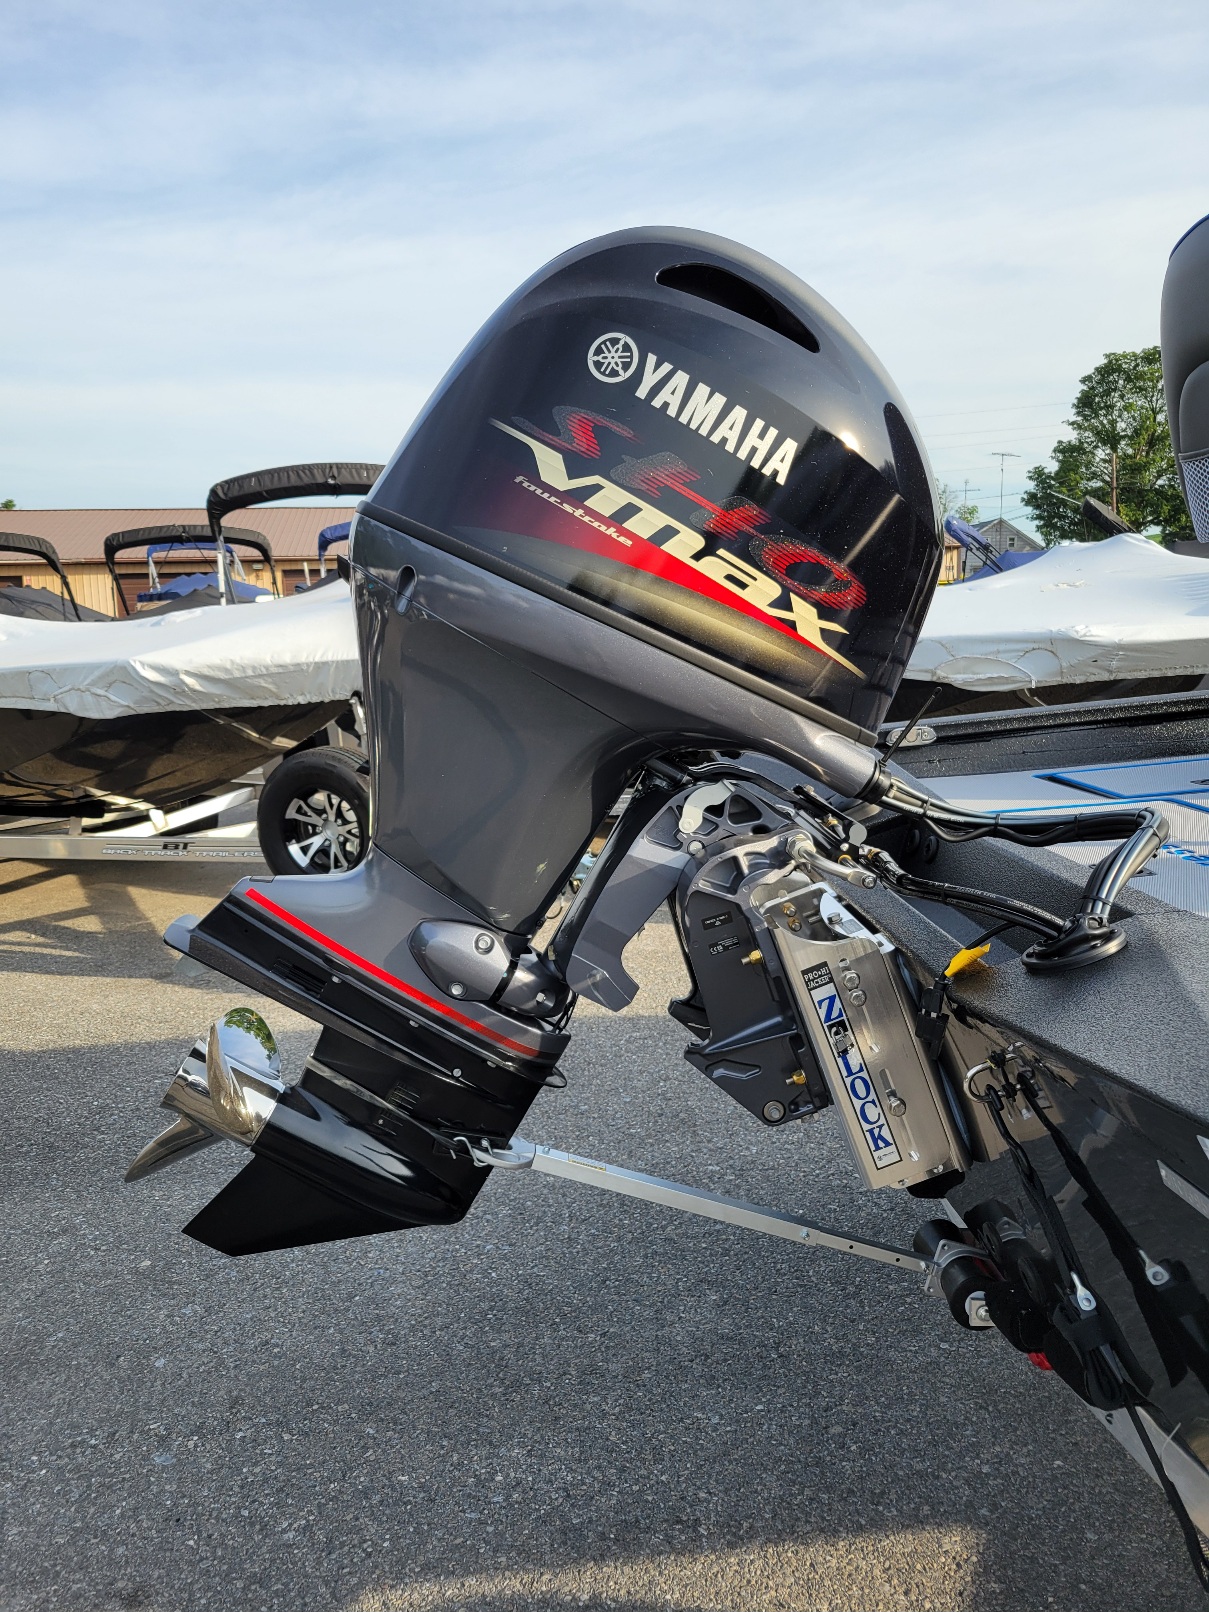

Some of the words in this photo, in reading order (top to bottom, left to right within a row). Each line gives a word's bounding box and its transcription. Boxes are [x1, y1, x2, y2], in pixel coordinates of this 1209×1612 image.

[634, 352, 798, 486] YAMAHA
[162, 842, 196, 850] BT
[143, 849, 191, 857] TRACK
